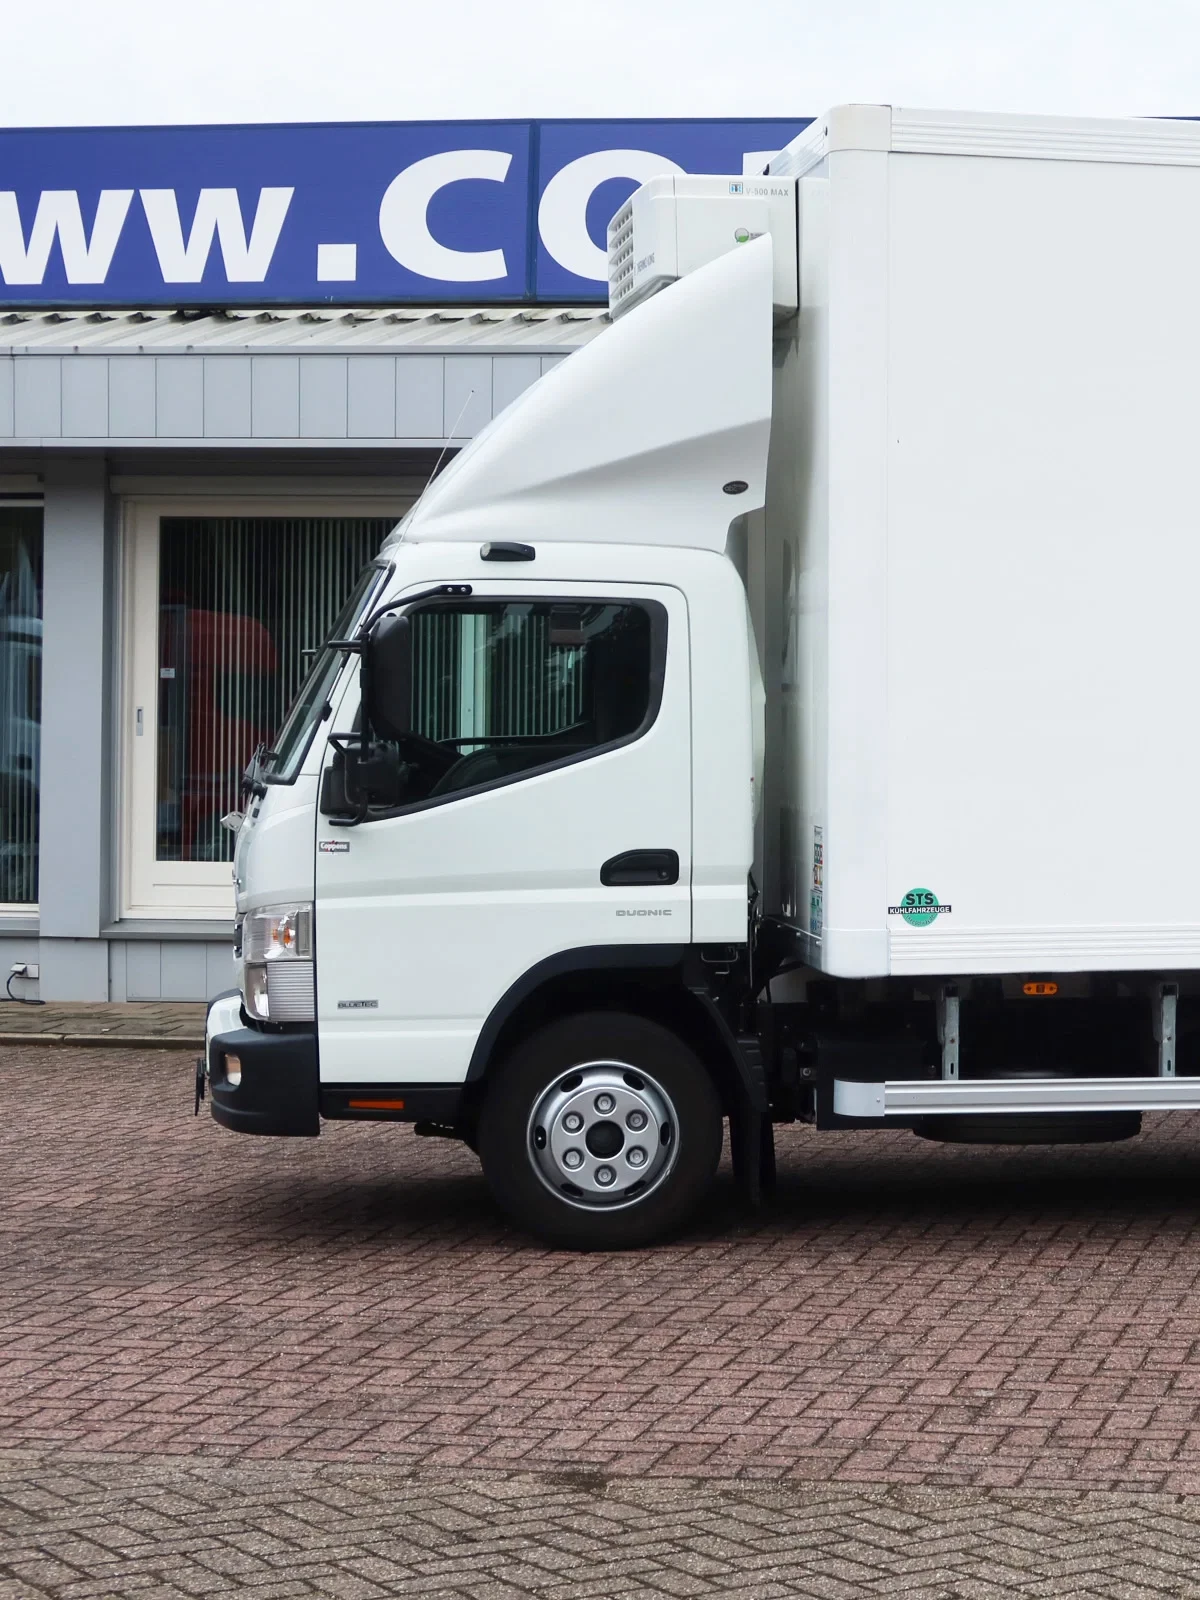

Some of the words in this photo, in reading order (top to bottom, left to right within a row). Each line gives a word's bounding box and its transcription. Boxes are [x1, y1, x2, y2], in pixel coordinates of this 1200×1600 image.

[771, 189, 789, 197] MAX
[905, 893, 934, 906] STS
[615, 909, 672, 917] DUONIC
[889, 906, 950, 914] KÜHLFAHRZEUGE
